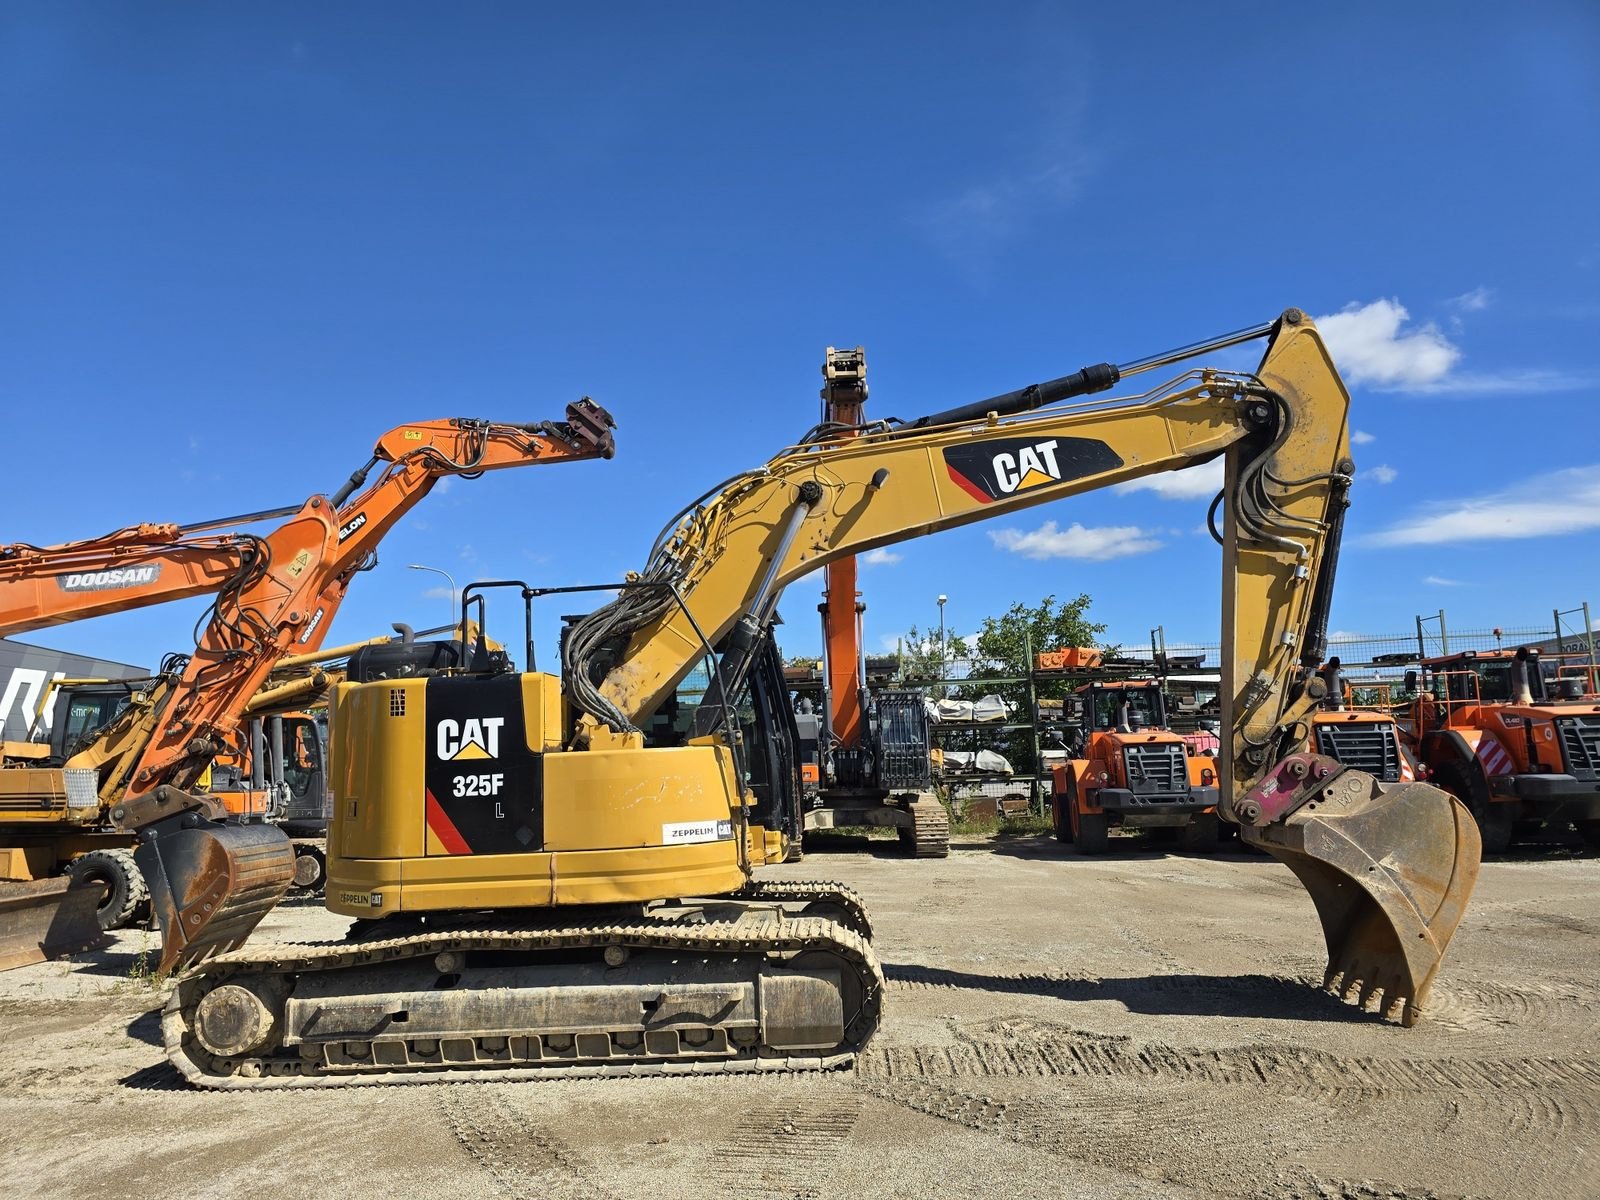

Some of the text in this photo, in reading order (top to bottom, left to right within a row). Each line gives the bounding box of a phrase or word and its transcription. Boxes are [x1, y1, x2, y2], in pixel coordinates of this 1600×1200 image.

[992, 440, 1061, 493] CAT
[65, 567, 154, 588] DOOSAN
[301, 608, 324, 643] DOOSAN
[437, 717, 504, 761] CAT
[452, 773, 504, 798] 325F
[495, 802, 505, 819] L
[671, 827, 714, 838] ZEPPELIN
[340, 893, 382, 905] ZEPPELIN CAT
